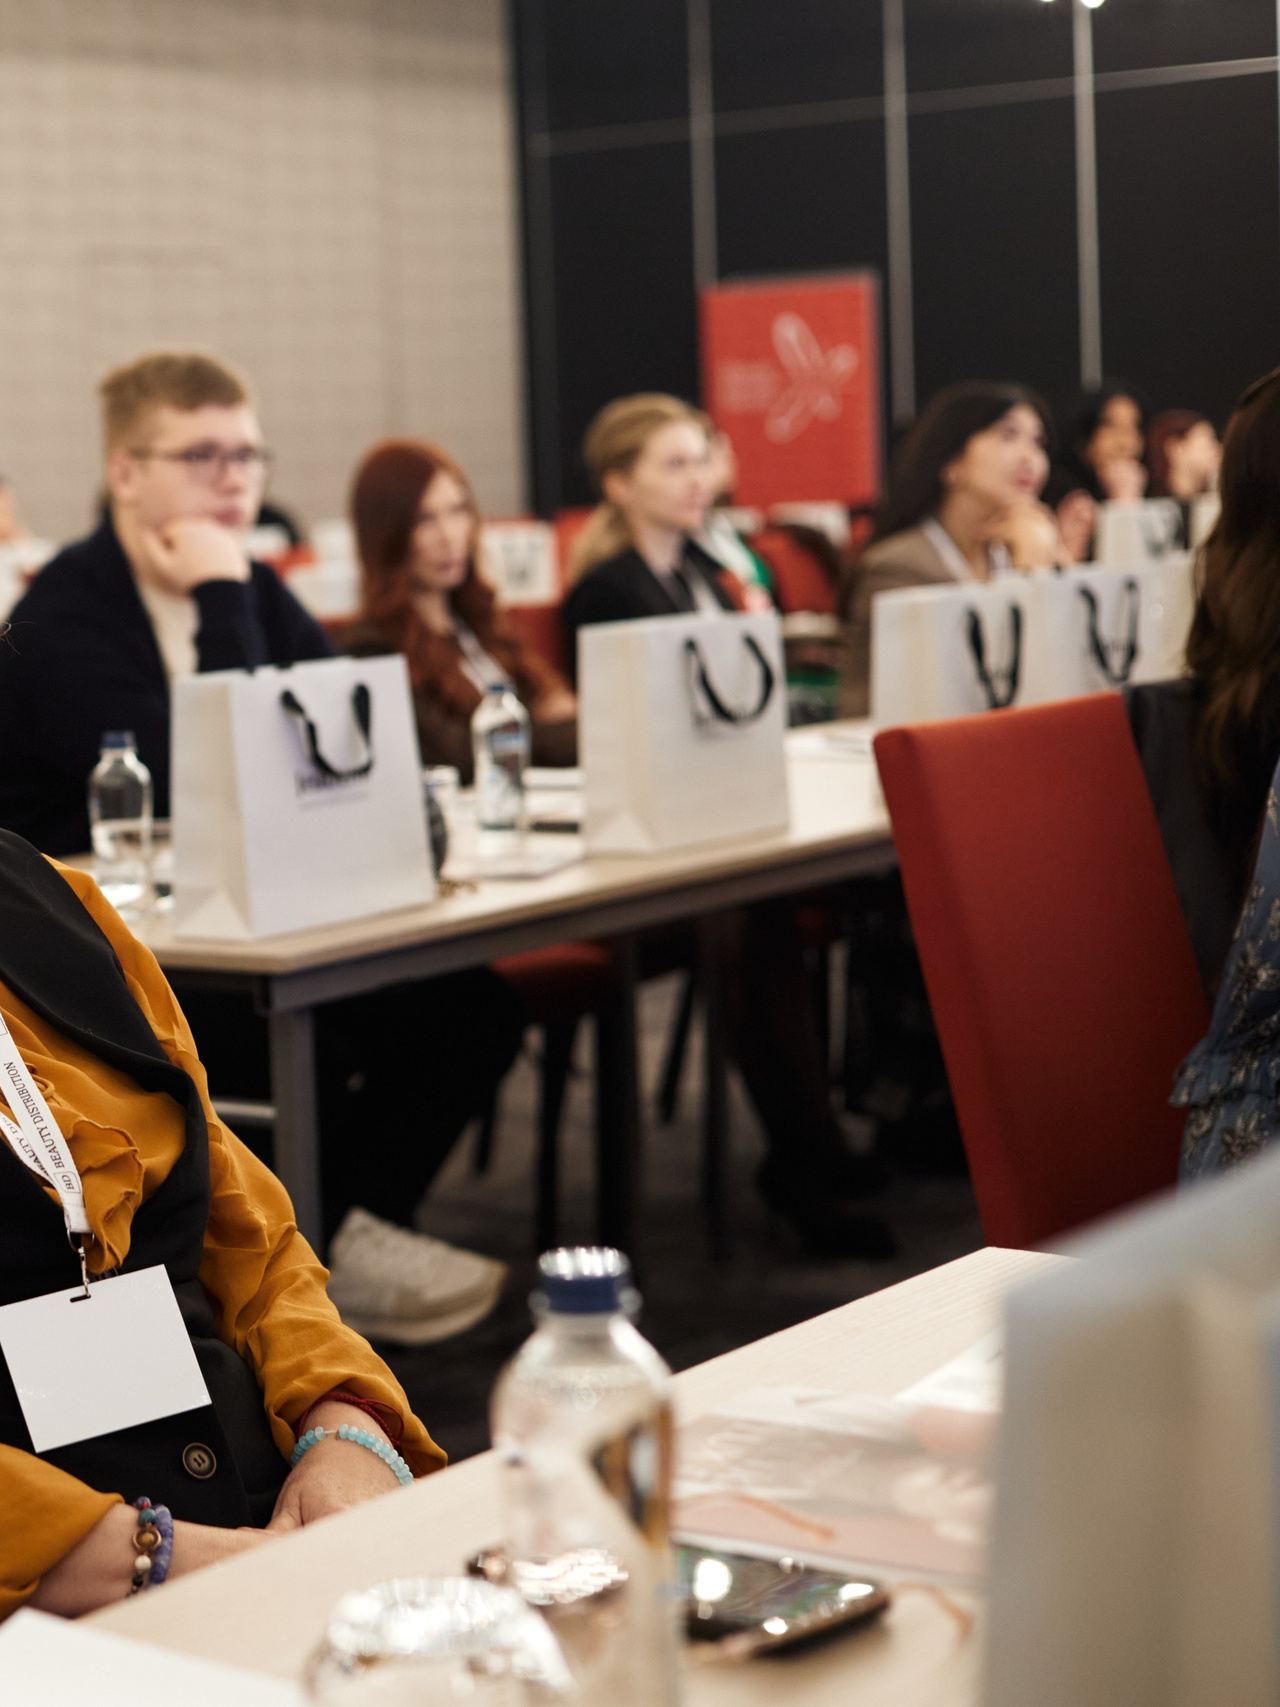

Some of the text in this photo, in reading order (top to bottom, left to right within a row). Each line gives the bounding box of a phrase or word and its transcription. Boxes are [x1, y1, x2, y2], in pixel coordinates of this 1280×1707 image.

[3, 1061, 45, 1126] DISTRIBUTION
[36, 1126, 65, 1169] BEAUTY
[61, 1174, 75, 1190] BD
